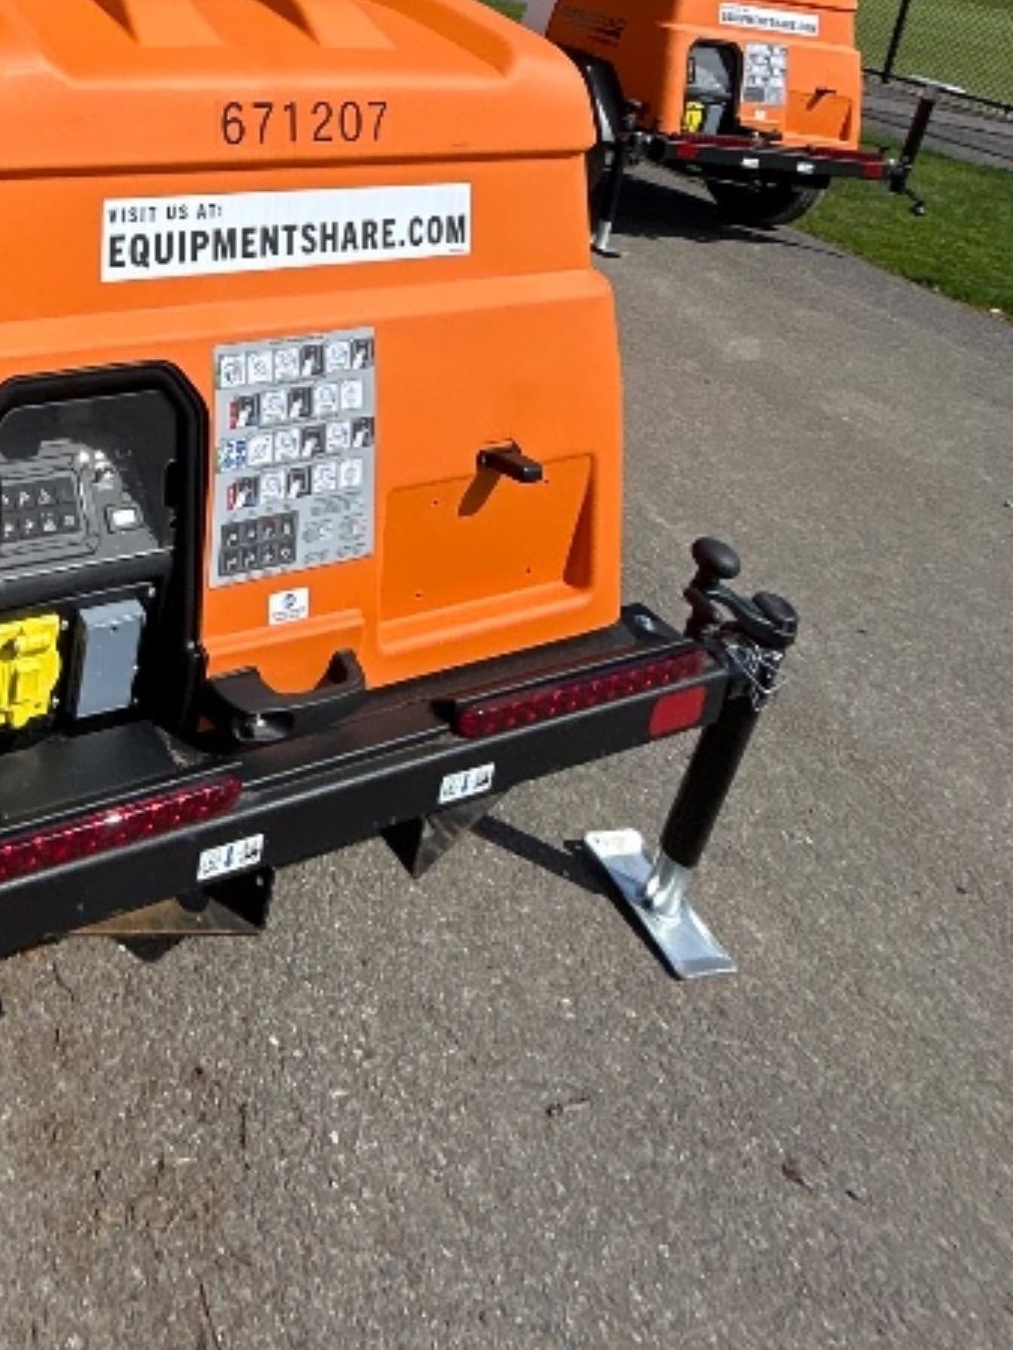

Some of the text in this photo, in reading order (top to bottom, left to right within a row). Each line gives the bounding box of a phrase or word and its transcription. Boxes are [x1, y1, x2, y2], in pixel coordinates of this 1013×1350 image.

[221, 101, 389, 145] 671207
[108, 203, 223, 224] VISIT US AT:
[108, 214, 467, 269] EQUIPMENTSHARE.COM
